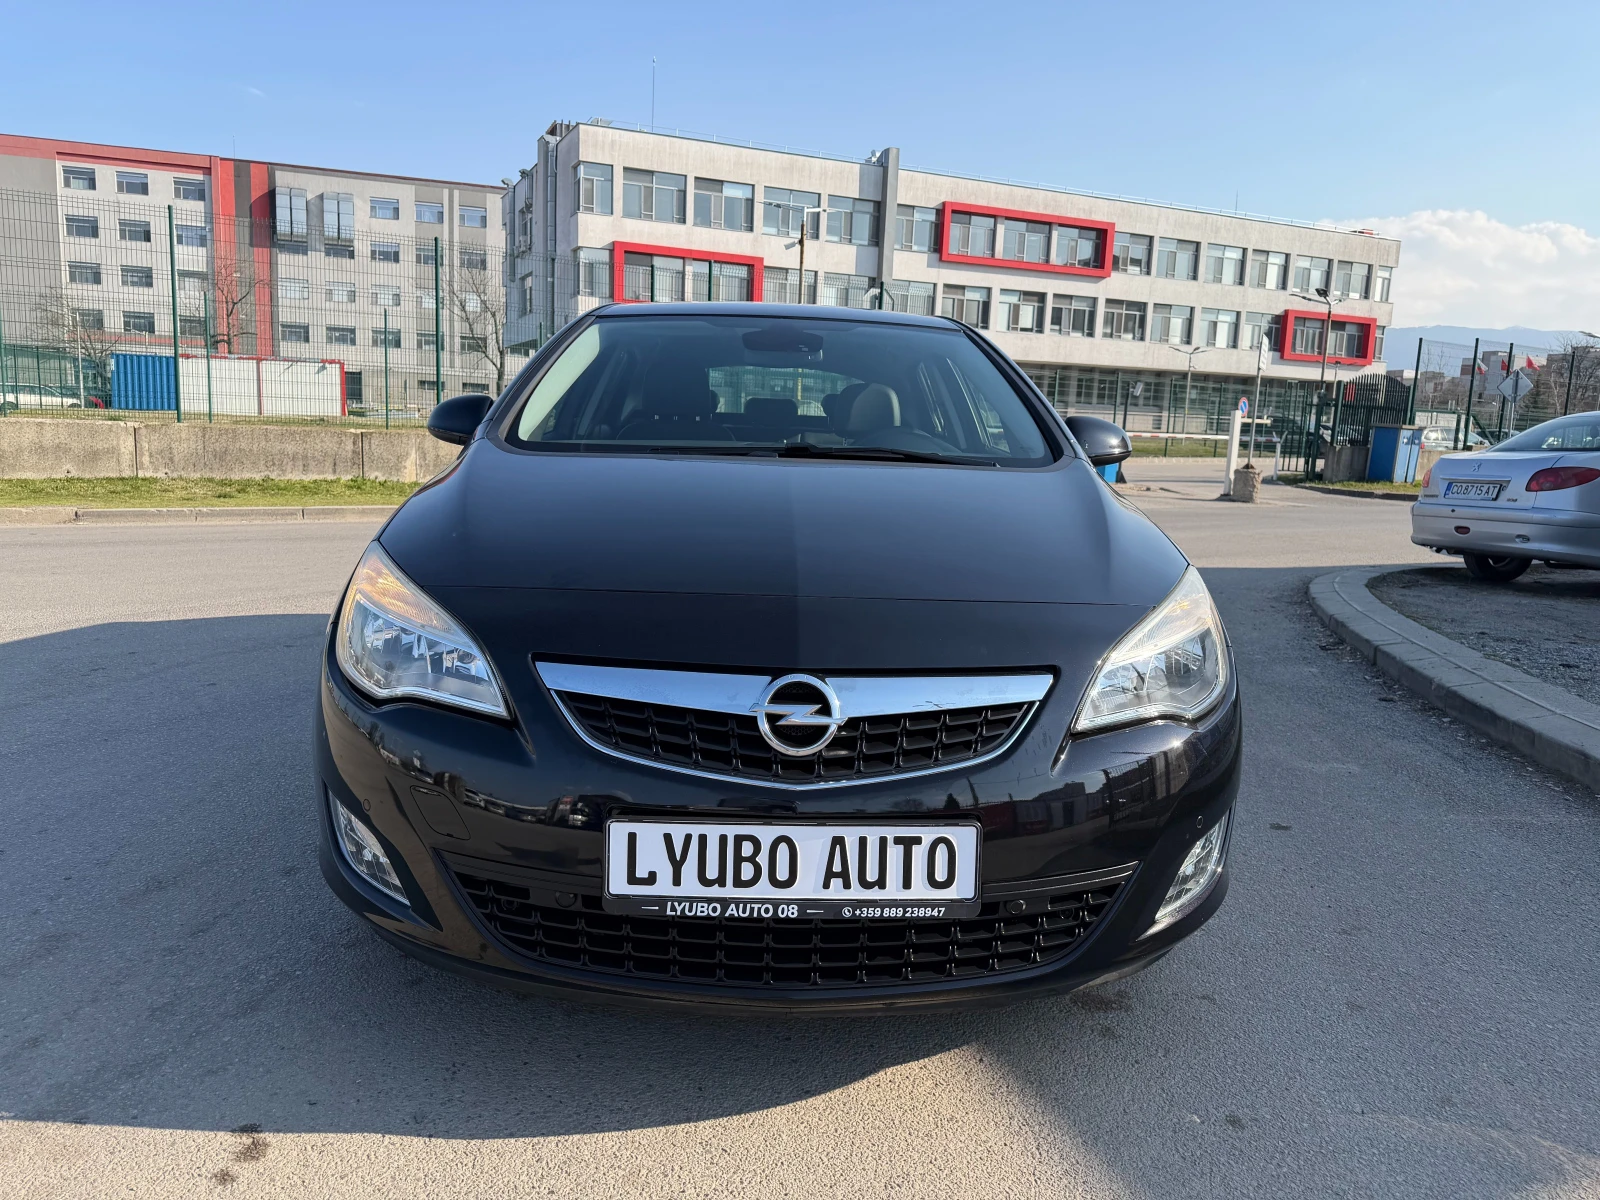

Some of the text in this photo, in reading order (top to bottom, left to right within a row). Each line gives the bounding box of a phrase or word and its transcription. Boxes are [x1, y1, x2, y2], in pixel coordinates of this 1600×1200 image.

[626, 831, 958, 891] LYUBO AUTO
[666, 901, 799, 918] LYUBO AUTO 08
[854, 907, 946, 917] +359 889 238947
